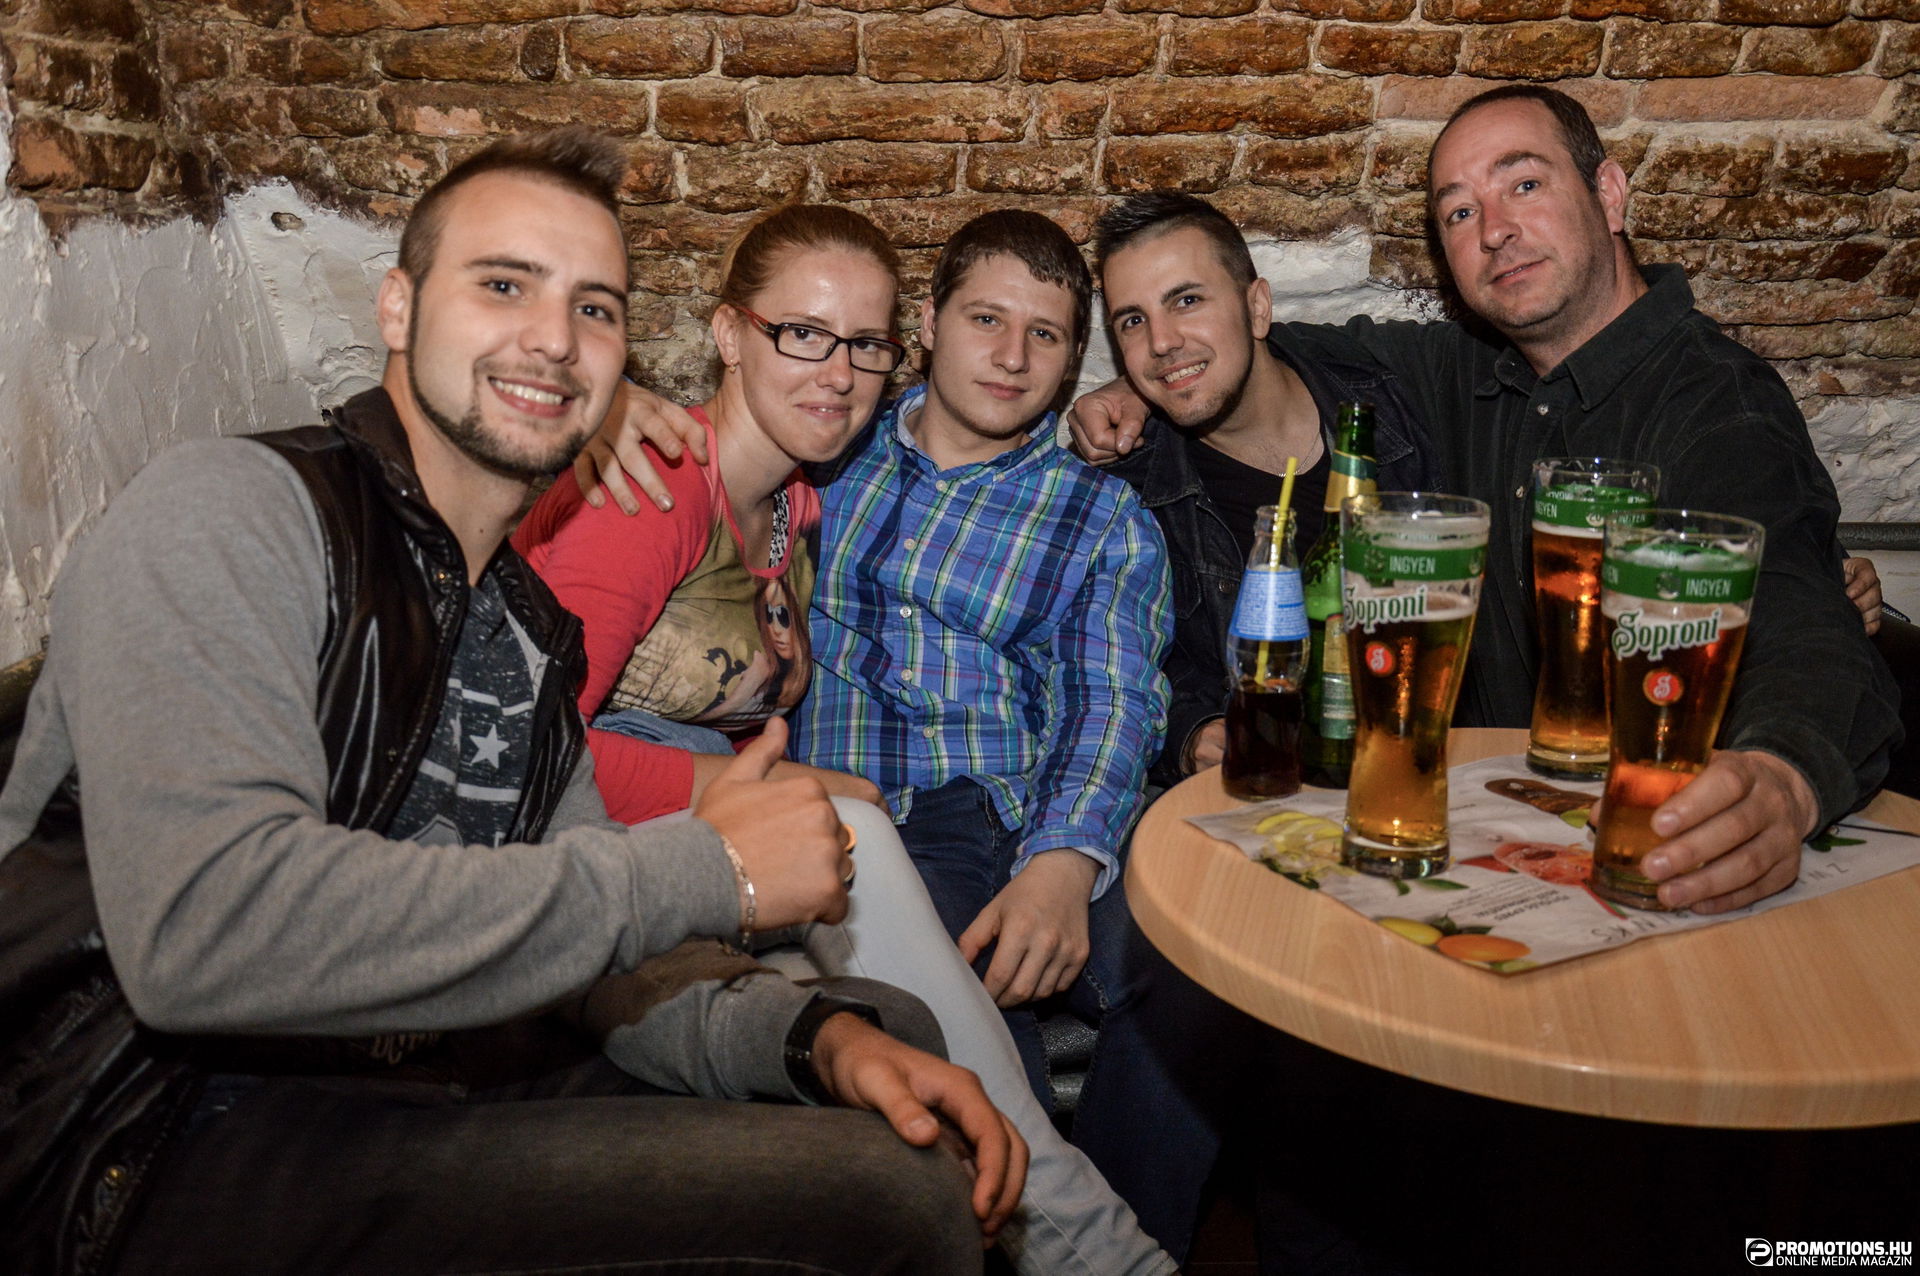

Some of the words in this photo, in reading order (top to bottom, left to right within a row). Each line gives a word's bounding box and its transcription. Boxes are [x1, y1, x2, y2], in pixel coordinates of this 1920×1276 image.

[1389, 555, 1436, 575] INGYEN
[1685, 577, 1732, 597] INGYEN
[1343, 584, 1428, 634] Soproni
[1612, 607, 1722, 662] Soproni
